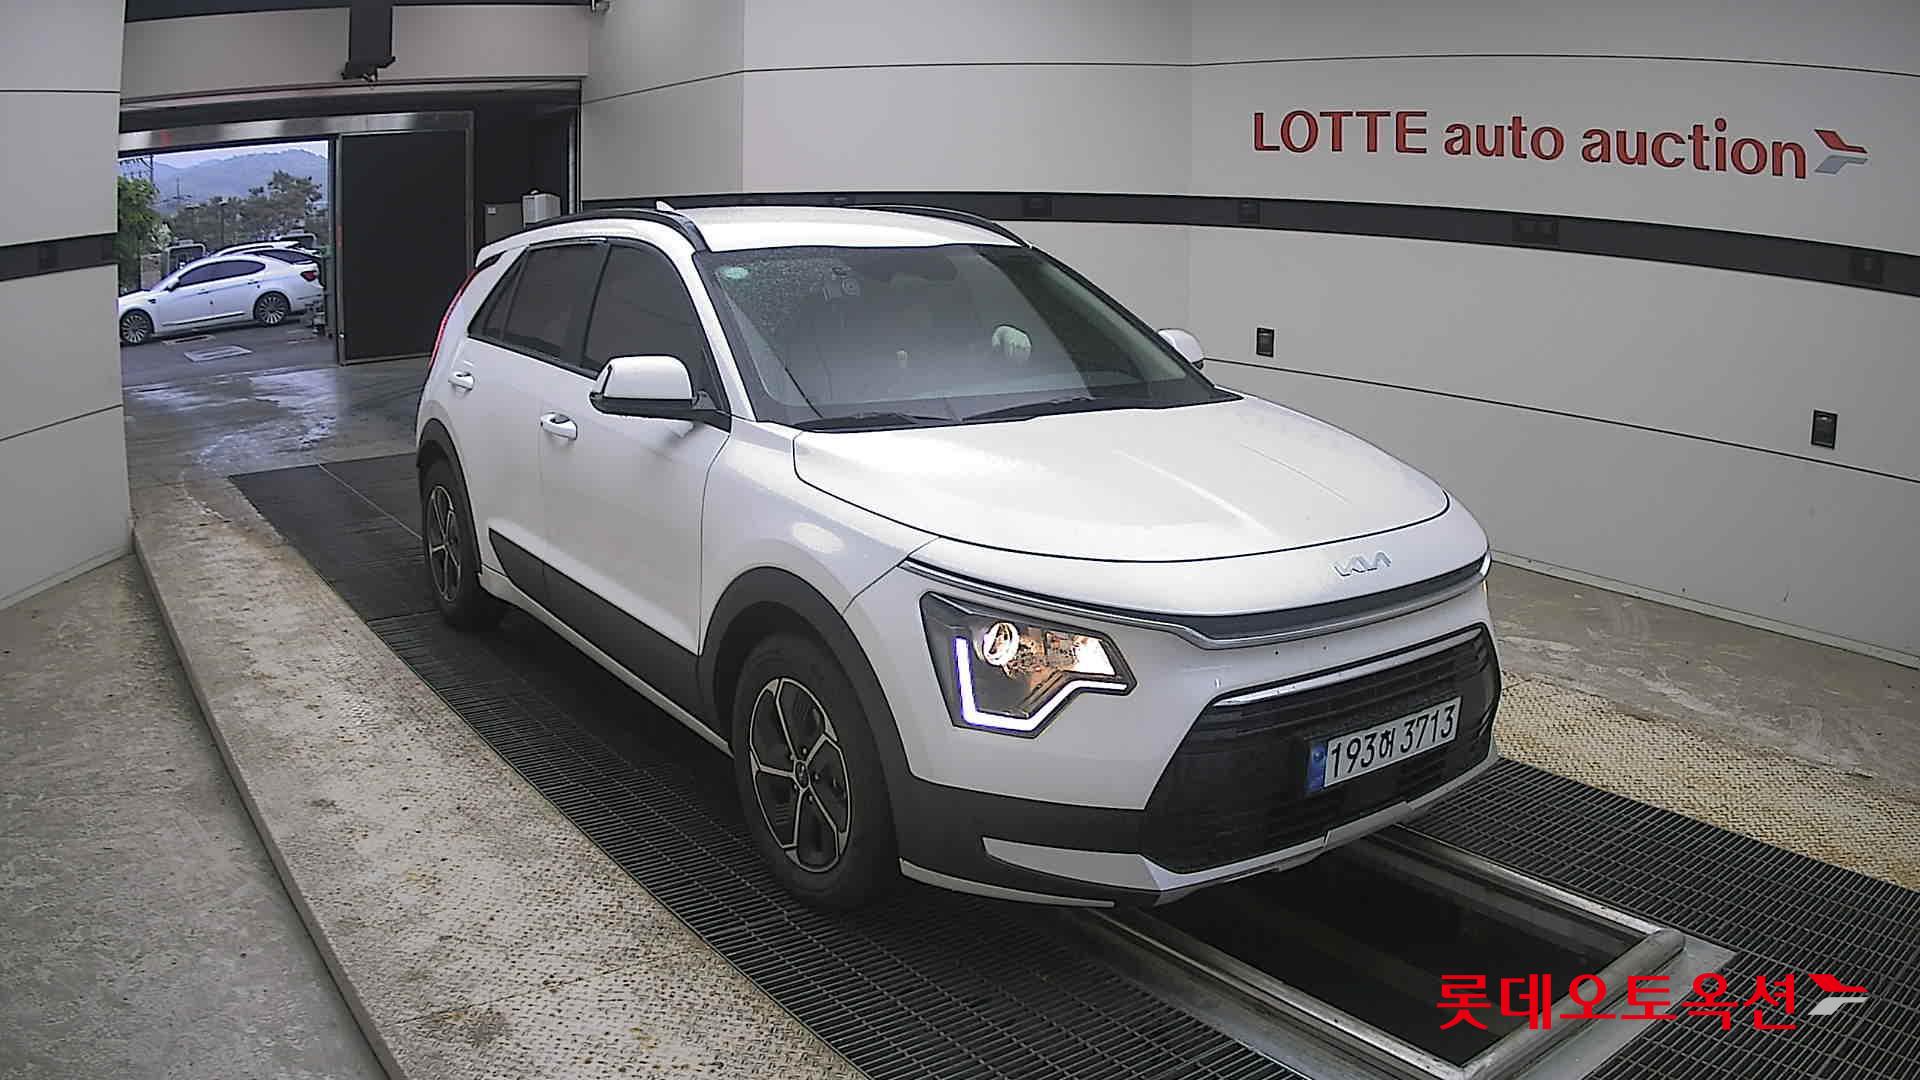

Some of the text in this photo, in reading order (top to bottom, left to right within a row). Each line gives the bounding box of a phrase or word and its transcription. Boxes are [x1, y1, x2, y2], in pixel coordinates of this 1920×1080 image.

[1253, 110, 1808, 180] LOTTE auto auction
[1331, 704, 1456, 778] 193허 3713
